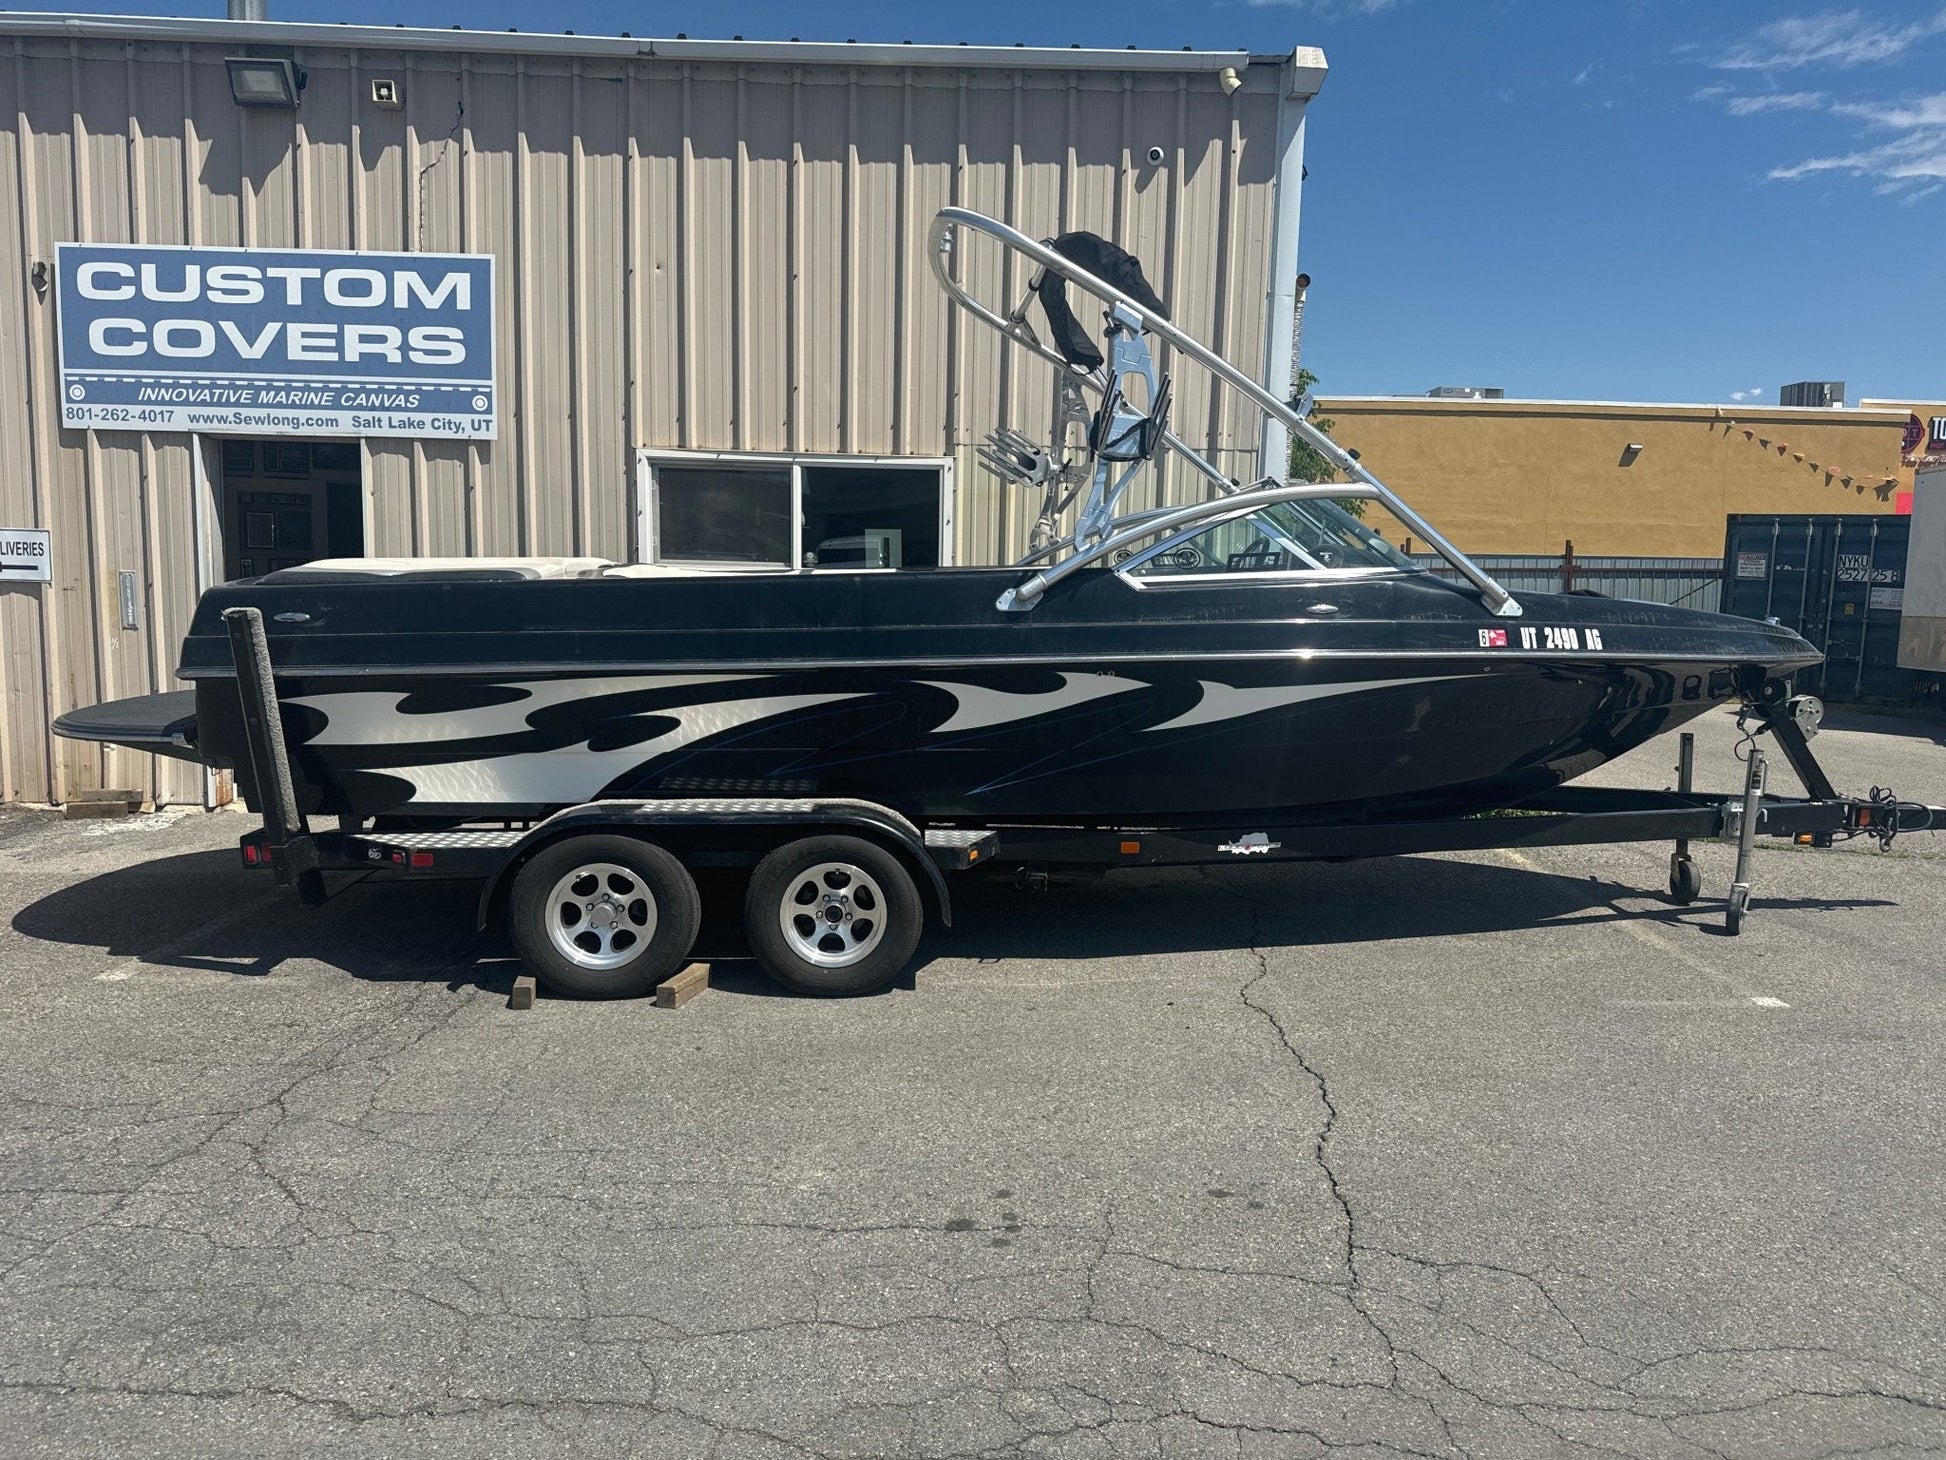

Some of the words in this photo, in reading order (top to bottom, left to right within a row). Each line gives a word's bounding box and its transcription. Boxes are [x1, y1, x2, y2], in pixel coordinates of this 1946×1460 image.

[76, 261, 471, 310] CUSTOM
[88, 317, 467, 365] COVERS
[138, 387, 254, 404] INNOVATIVE
[258, 390, 335, 406] MARINE
[340, 392, 420, 408] CANVAS
[66, 406, 174, 423] 801-262-4017
[188, 411, 339, 429] www.Sewlong.com
[352, 415, 383, 429] Salt
[388, 416, 425, 430] Lake
[431, 417, 465, 434] City,
[471, 419, 493, 432] UT
[1838, 554, 1868, 568] NYKU
[1520, 627, 1537, 649] UT
[1585, 629, 1603, 650] AG
